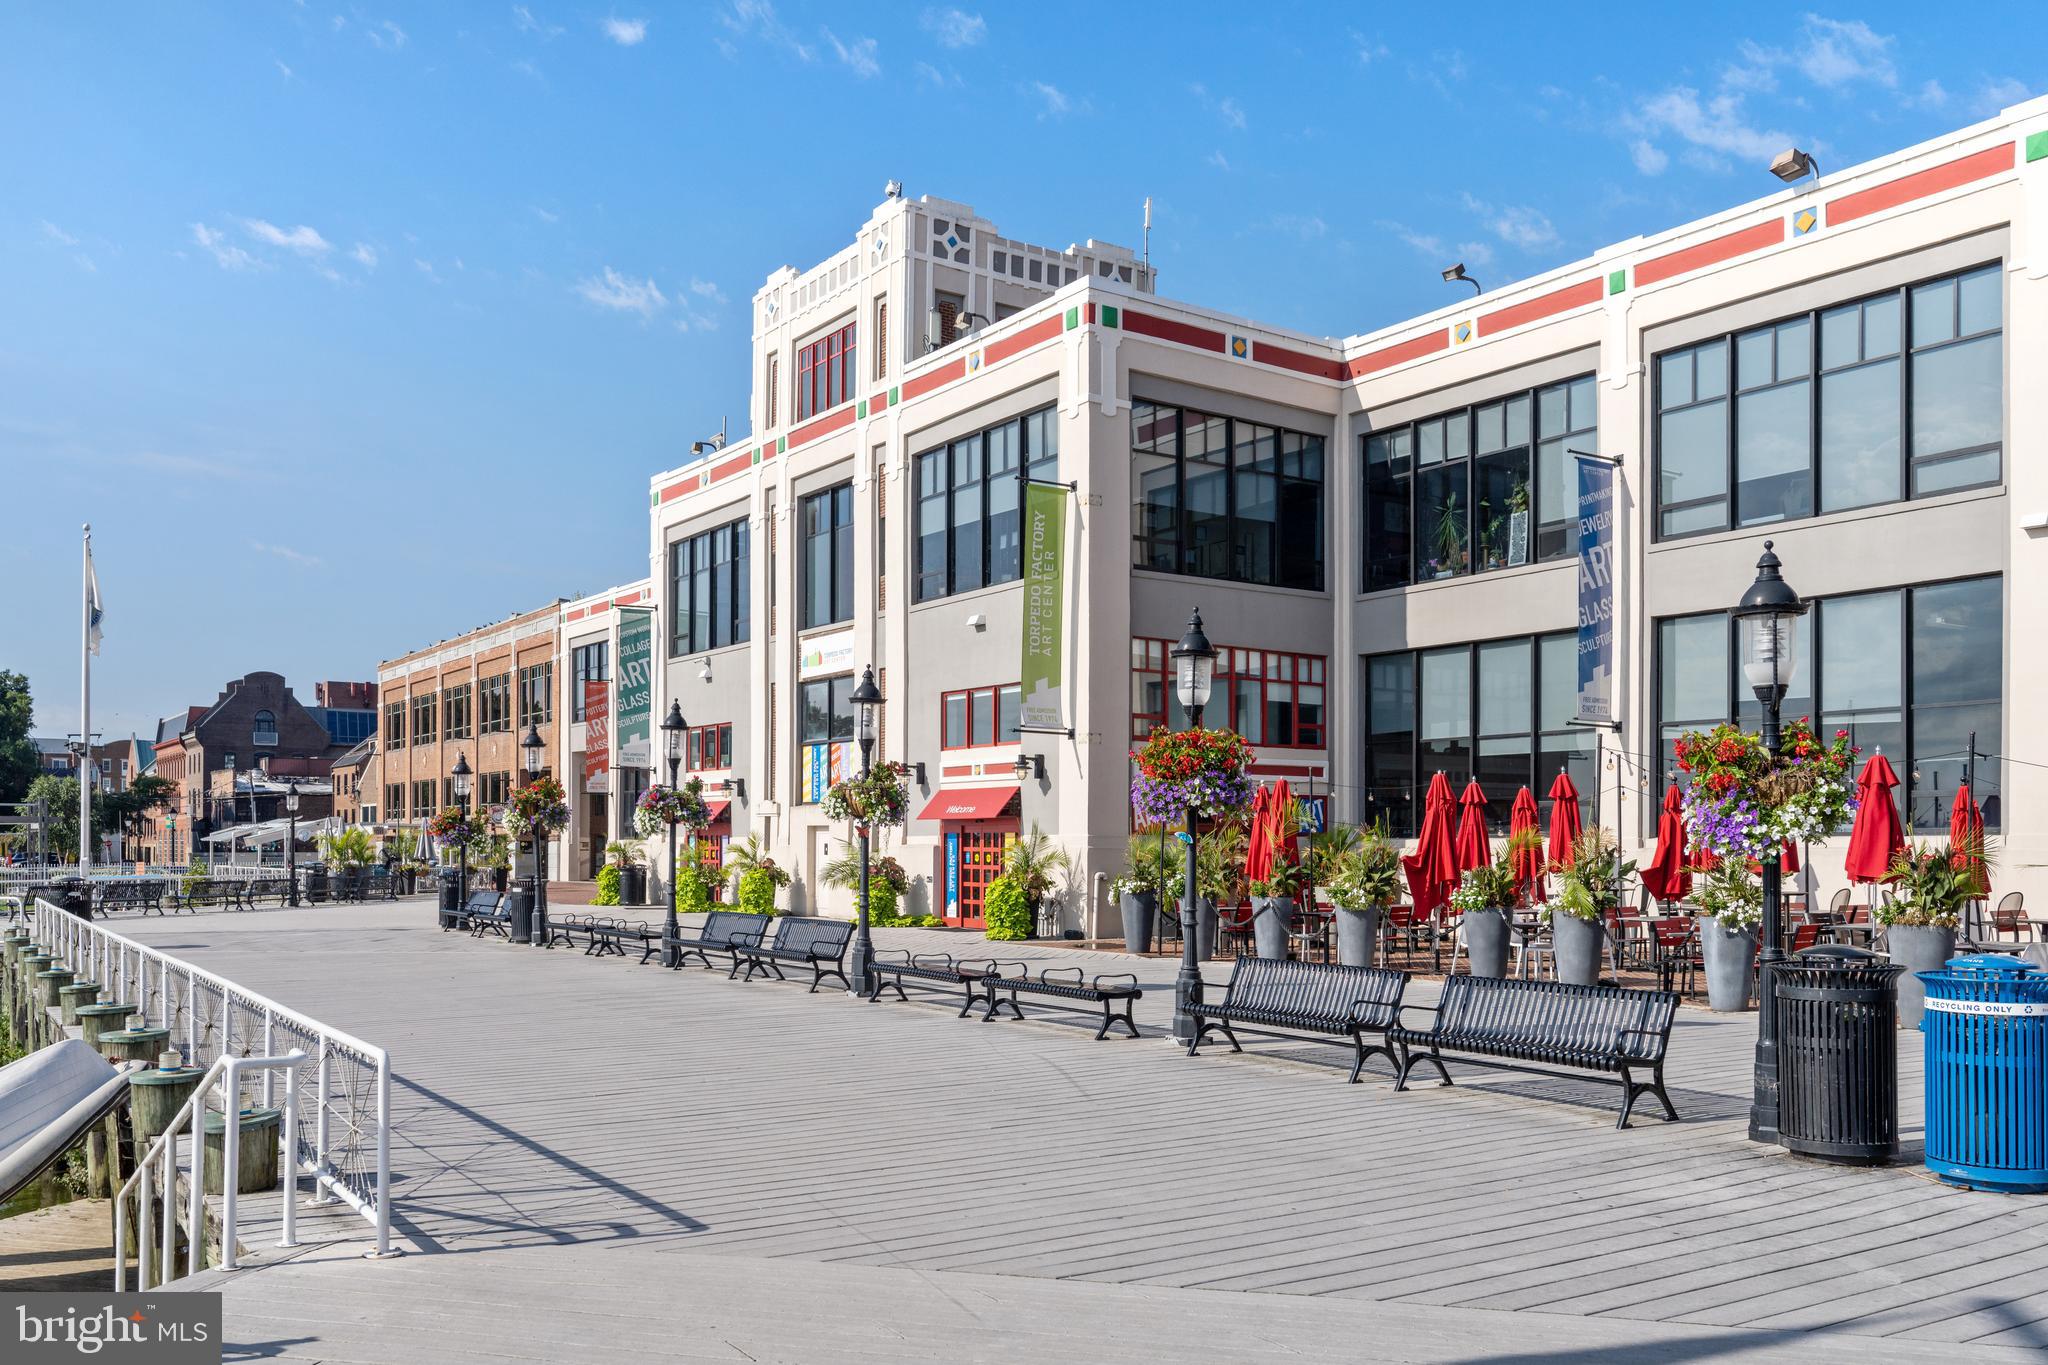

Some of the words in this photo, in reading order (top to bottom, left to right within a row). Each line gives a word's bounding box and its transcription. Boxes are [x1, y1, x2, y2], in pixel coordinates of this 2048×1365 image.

[1031, 511, 1045, 579] FACTORY
[1579, 541, 1612, 593] ART
[1042, 551, 1055, 618] CENTER
[1030, 585, 1041, 656] TORPEDO
[1578, 596, 1612, 628] GLASS
[619, 639, 651, 657] COLLAGE
[1042, 624, 1053, 656] ART
[618, 657, 651, 692] ART
[617, 690, 650, 712] GLASS
[1581, 704, 1596, 713] SINCE
[586, 715, 608, 741] ART
[586, 738, 608, 754] GLASS
[945, 805, 976, 814] Welcome
[1932, 1001, 1981, 1011] RECYCLING
[1985, 1005, 2013, 1013] ONLY
